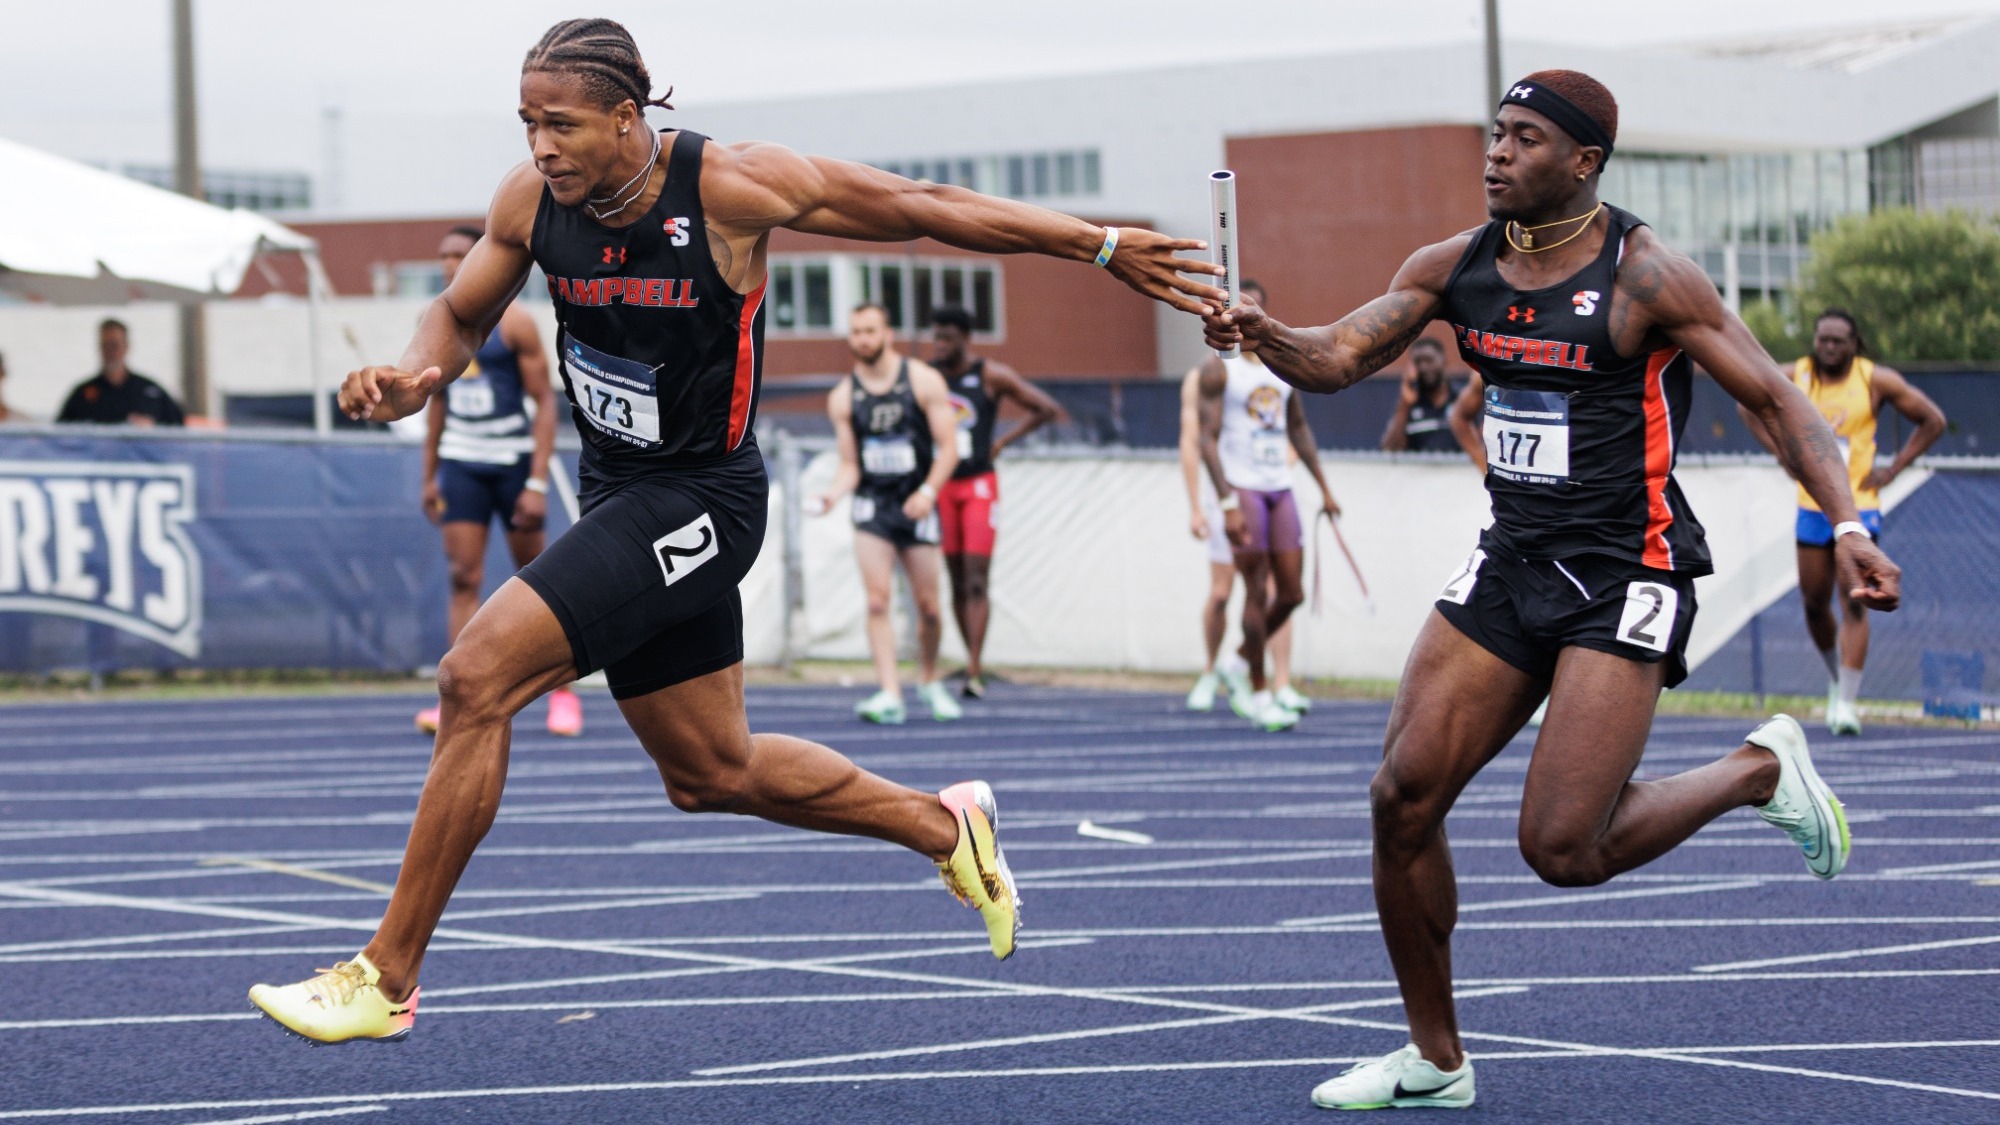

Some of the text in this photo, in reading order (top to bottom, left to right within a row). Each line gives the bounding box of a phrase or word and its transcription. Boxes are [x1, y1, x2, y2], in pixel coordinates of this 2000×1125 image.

[605, 372, 650, 391] CHAMPIONSHIPS
[583, 384, 633, 429] 173
[1497, 430, 1541, 467] 177
[659, 525, 712, 575] 2
[1441, 553, 1476, 598] 2
[1627, 586, 1663, 645] 2
